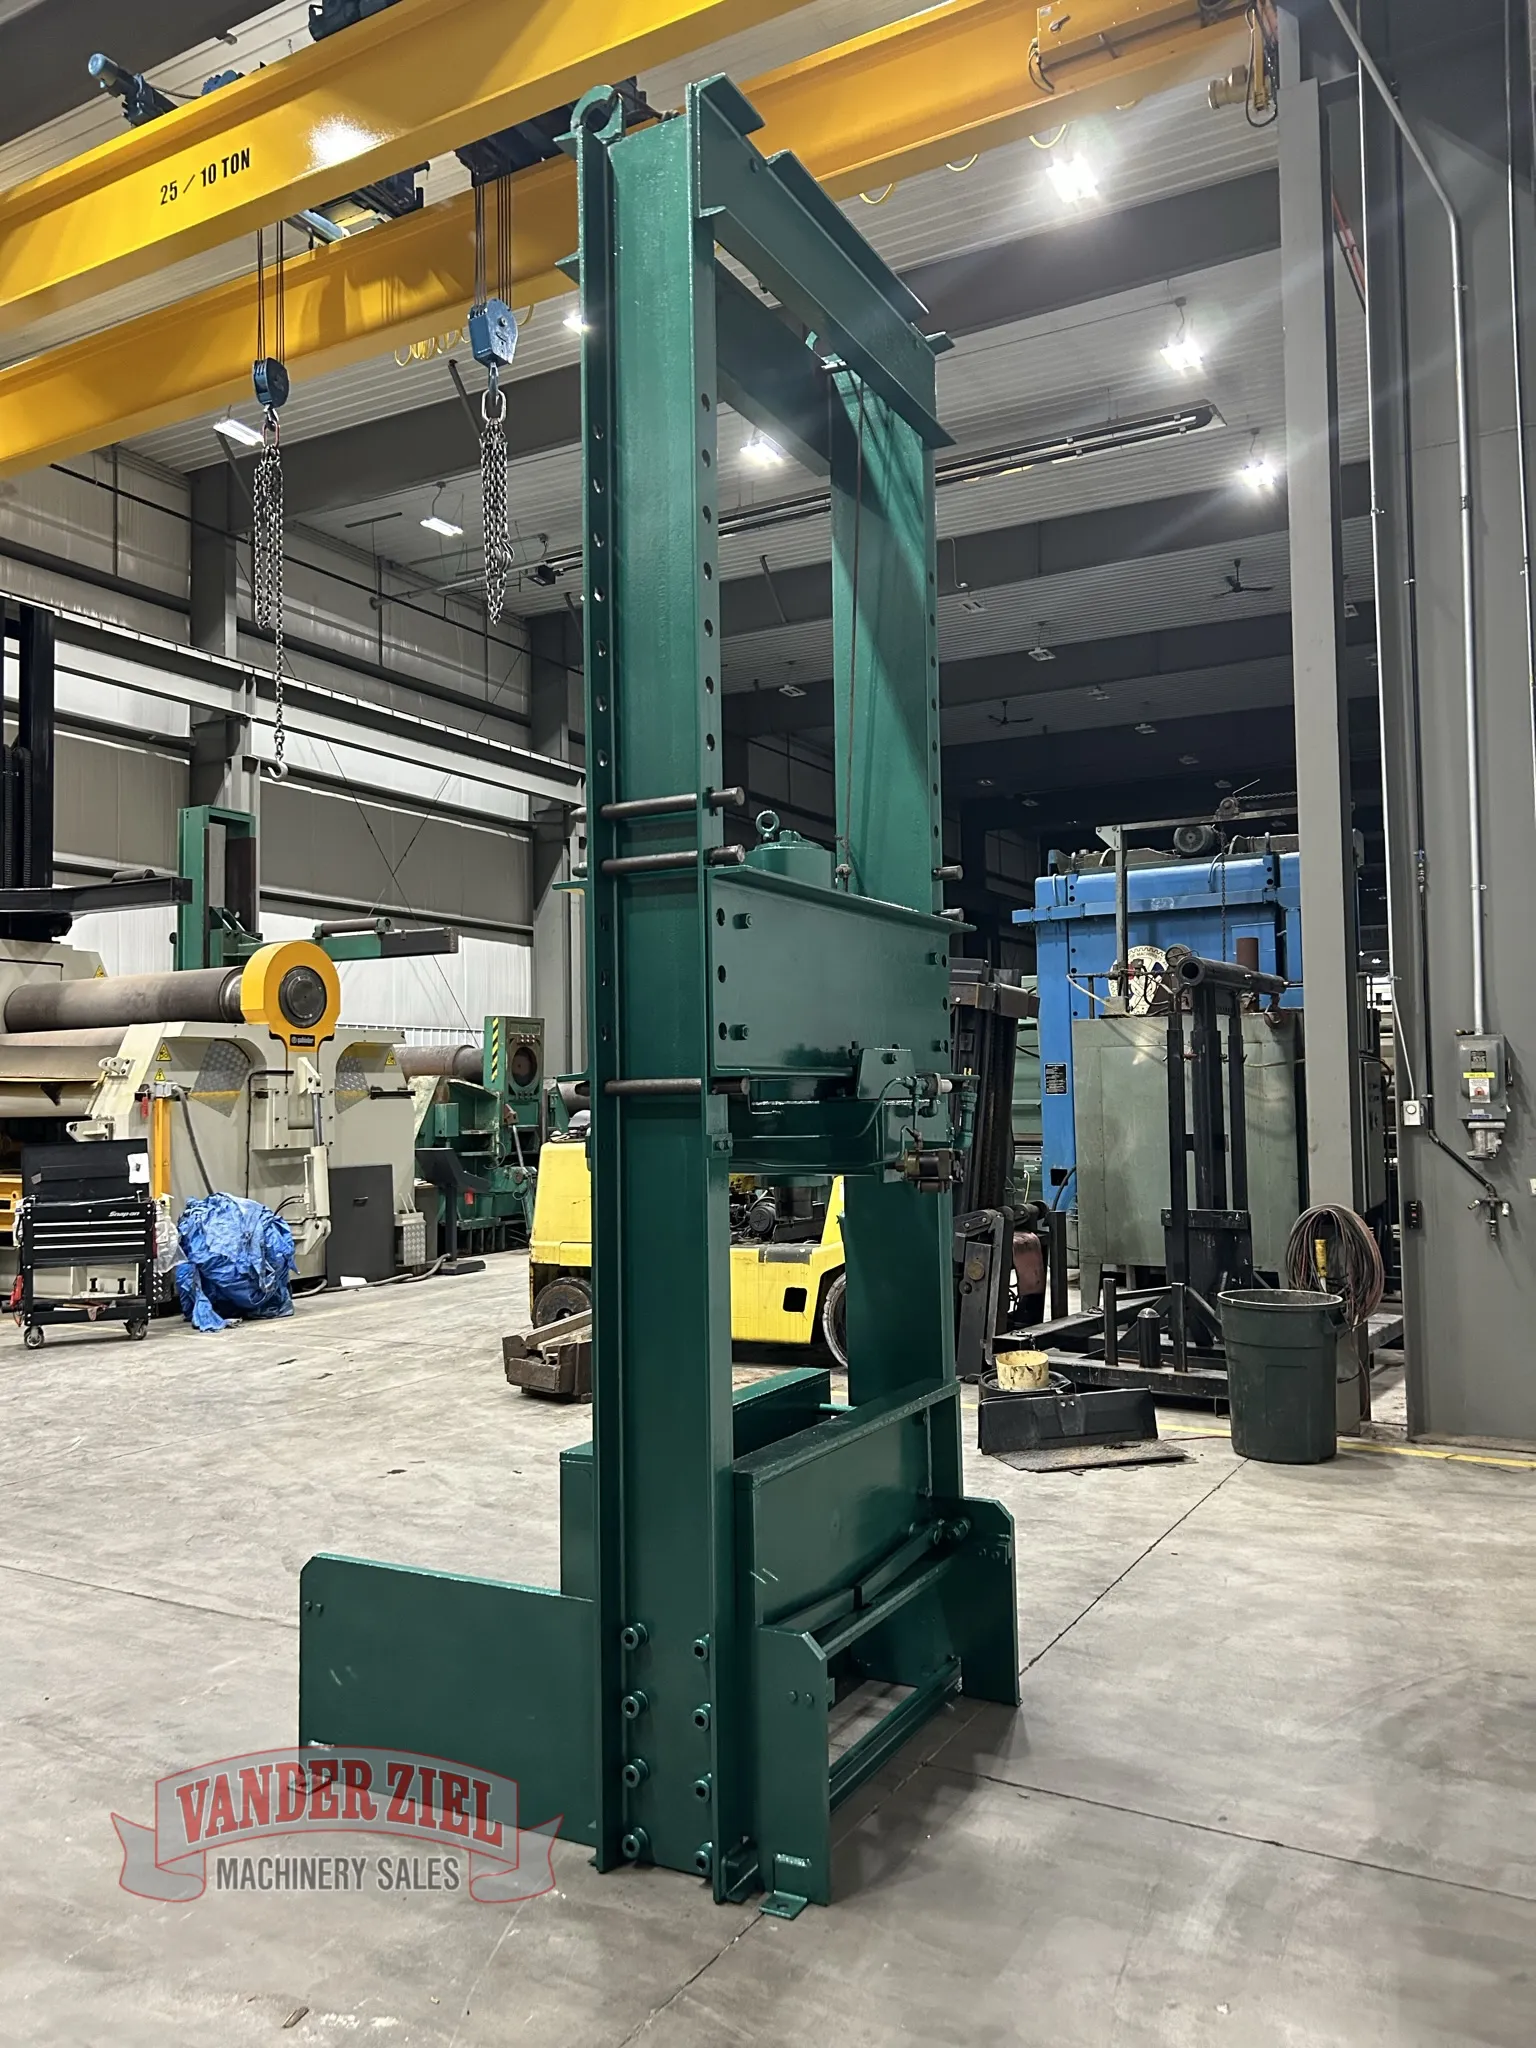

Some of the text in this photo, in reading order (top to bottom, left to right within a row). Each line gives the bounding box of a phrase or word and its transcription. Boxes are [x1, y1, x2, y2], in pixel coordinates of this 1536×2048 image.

[160, 147, 250, 206] 25 / 10 TON
